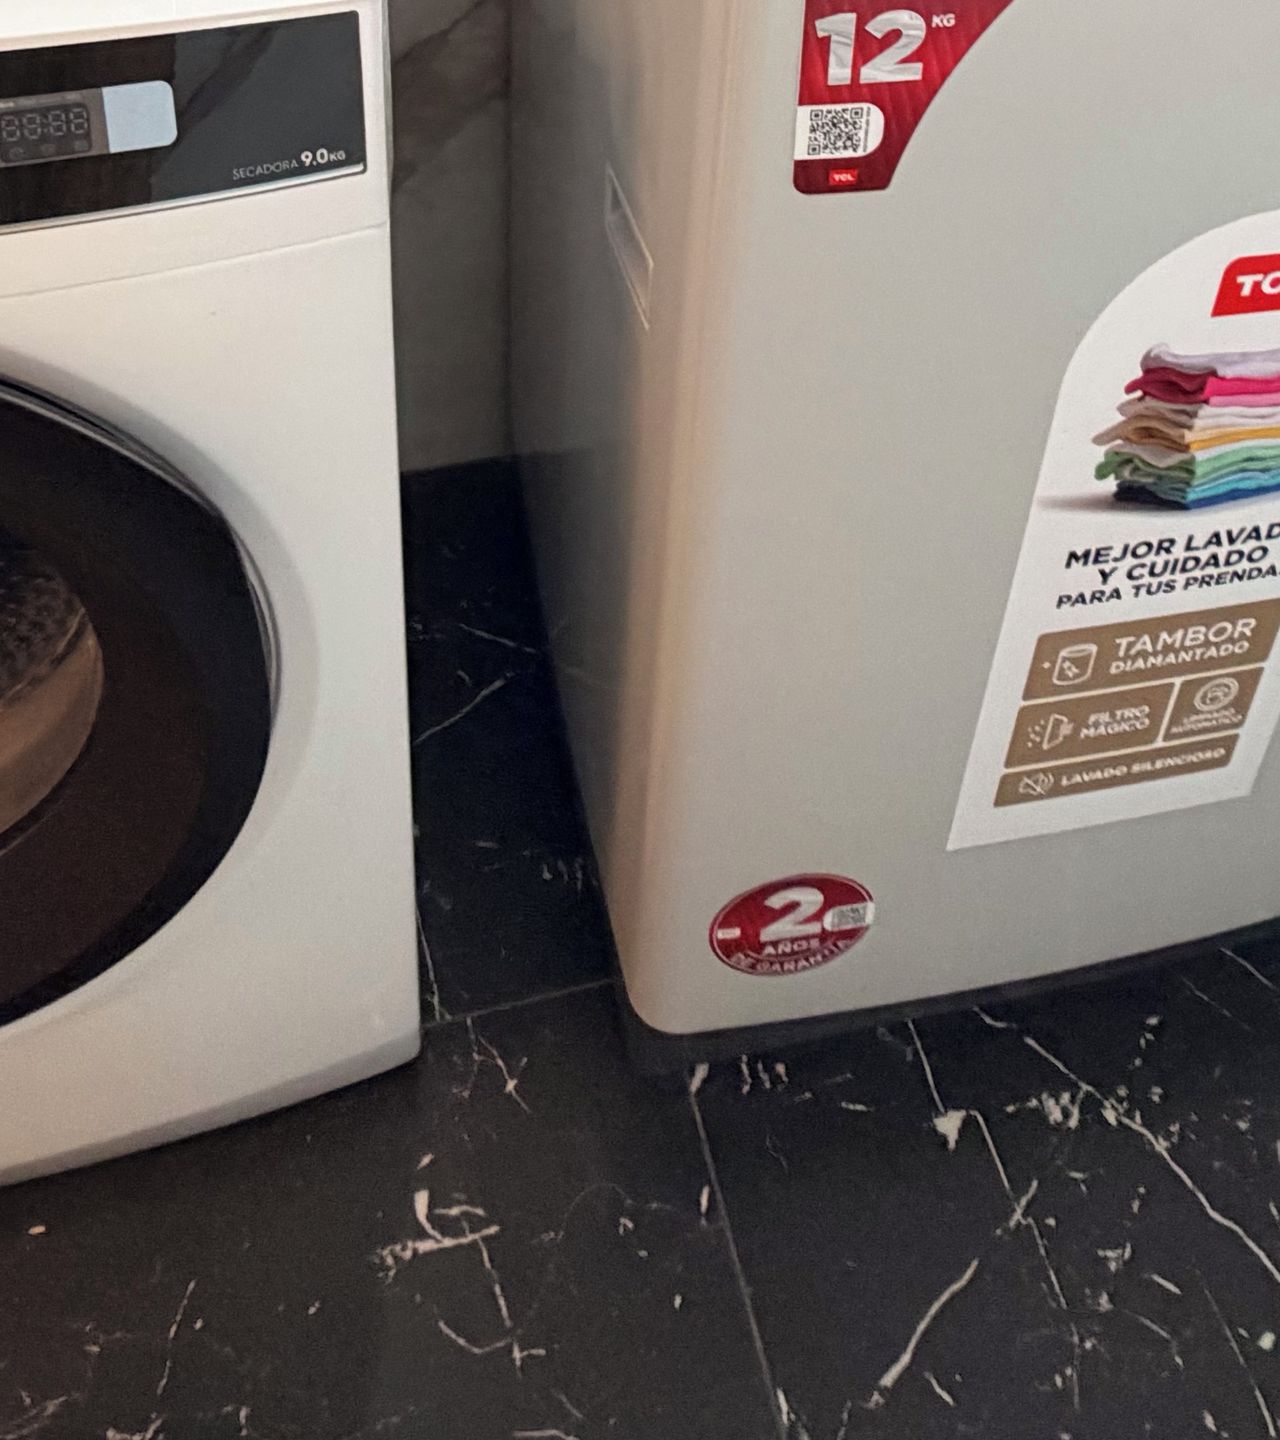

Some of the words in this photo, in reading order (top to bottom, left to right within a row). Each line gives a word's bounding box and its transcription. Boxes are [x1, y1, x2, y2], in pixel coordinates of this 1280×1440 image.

[814, 8, 927, 87] 12
[931, 13, 956, 29] KG
[233, 160, 299, 180] SECADORA
[301, 147, 329, 167] 9.0
[329, 150, 346, 162] KG
[1064, 537, 1176, 569] MEJOR
[1098, 566, 1118, 586] Y
[1126, 545, 1270, 581] CUIDADO
[1055, 587, 1123, 610] PARA
[1131, 579, 1177, 598] TUS
[1115, 617, 1256, 658] TAMBOR
[1109, 640, 1250, 674] DIAMANTADO
[1088, 704, 1150, 726] FILTRO
[1061, 765, 1128, 787] LAVADO
[1131, 747, 1226, 774] SILENCIOSO
[759, 886, 825, 943] 2
